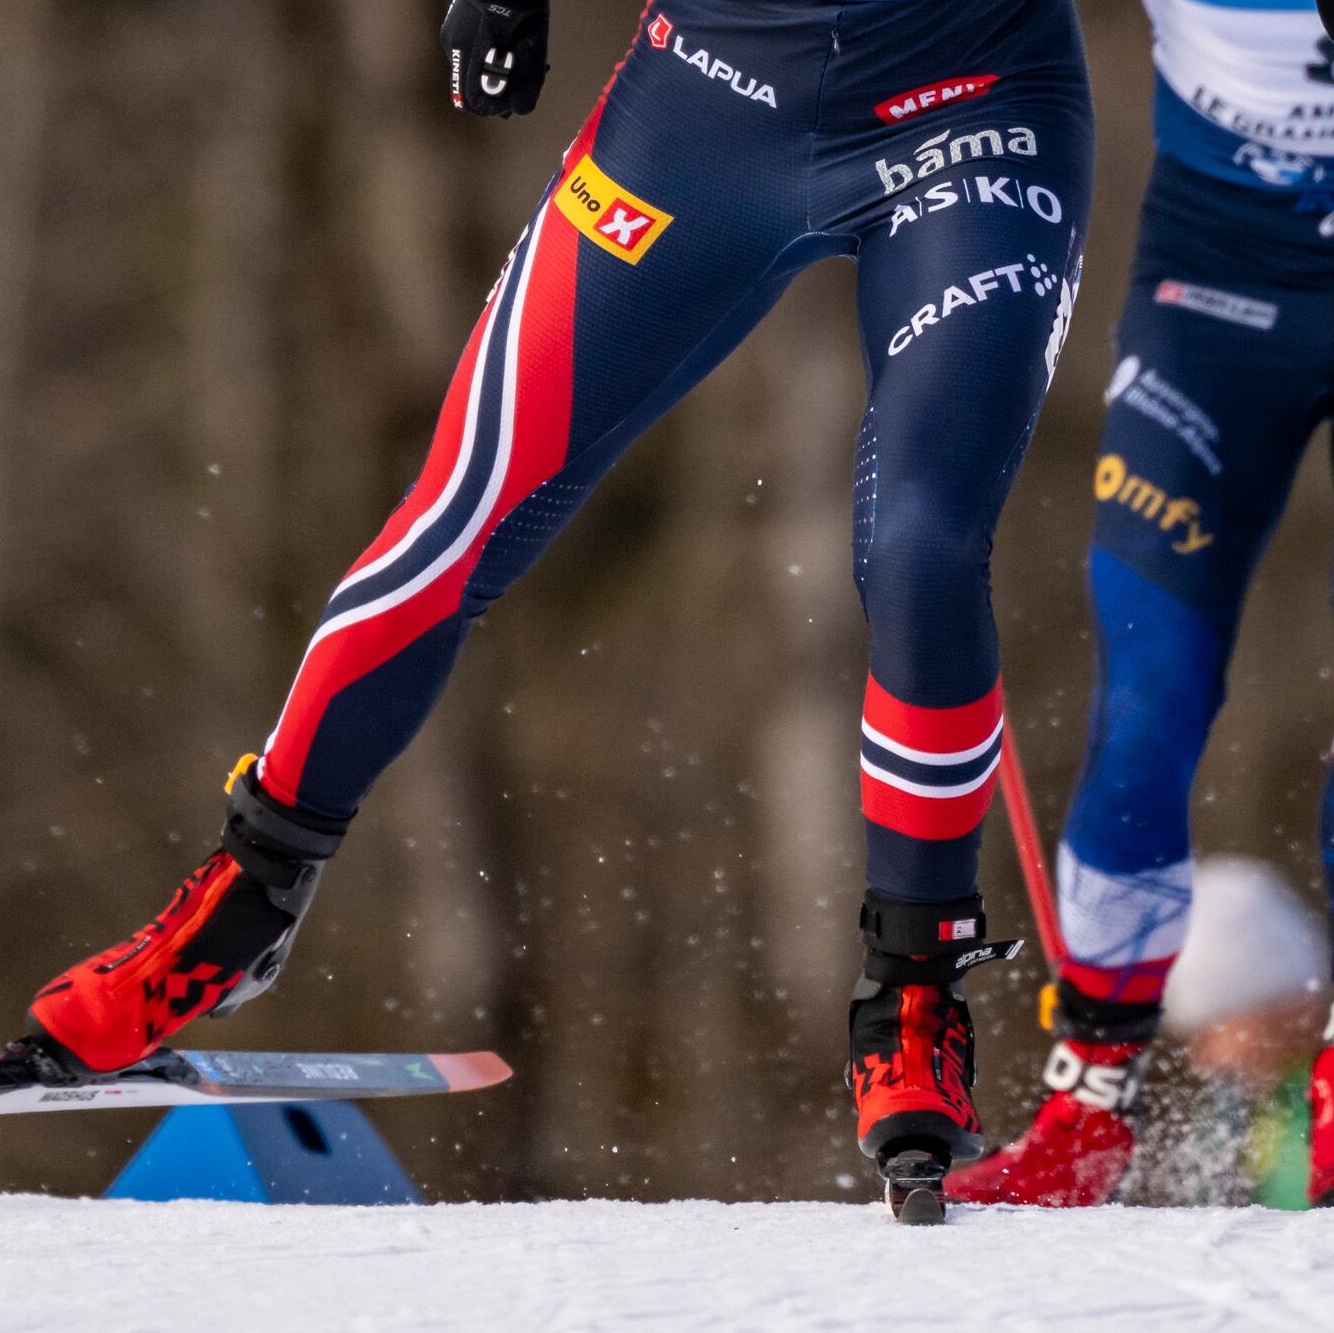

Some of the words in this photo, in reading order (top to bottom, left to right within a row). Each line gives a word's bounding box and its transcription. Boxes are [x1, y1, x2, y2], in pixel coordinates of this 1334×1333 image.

[451, 49, 463, 109] KINETIX
[672, 34, 778, 109] LAPUA
[570, 176, 601, 213] Uno
[599, 207, 650, 246] X
[887, 263, 1027, 357] CRAFT
